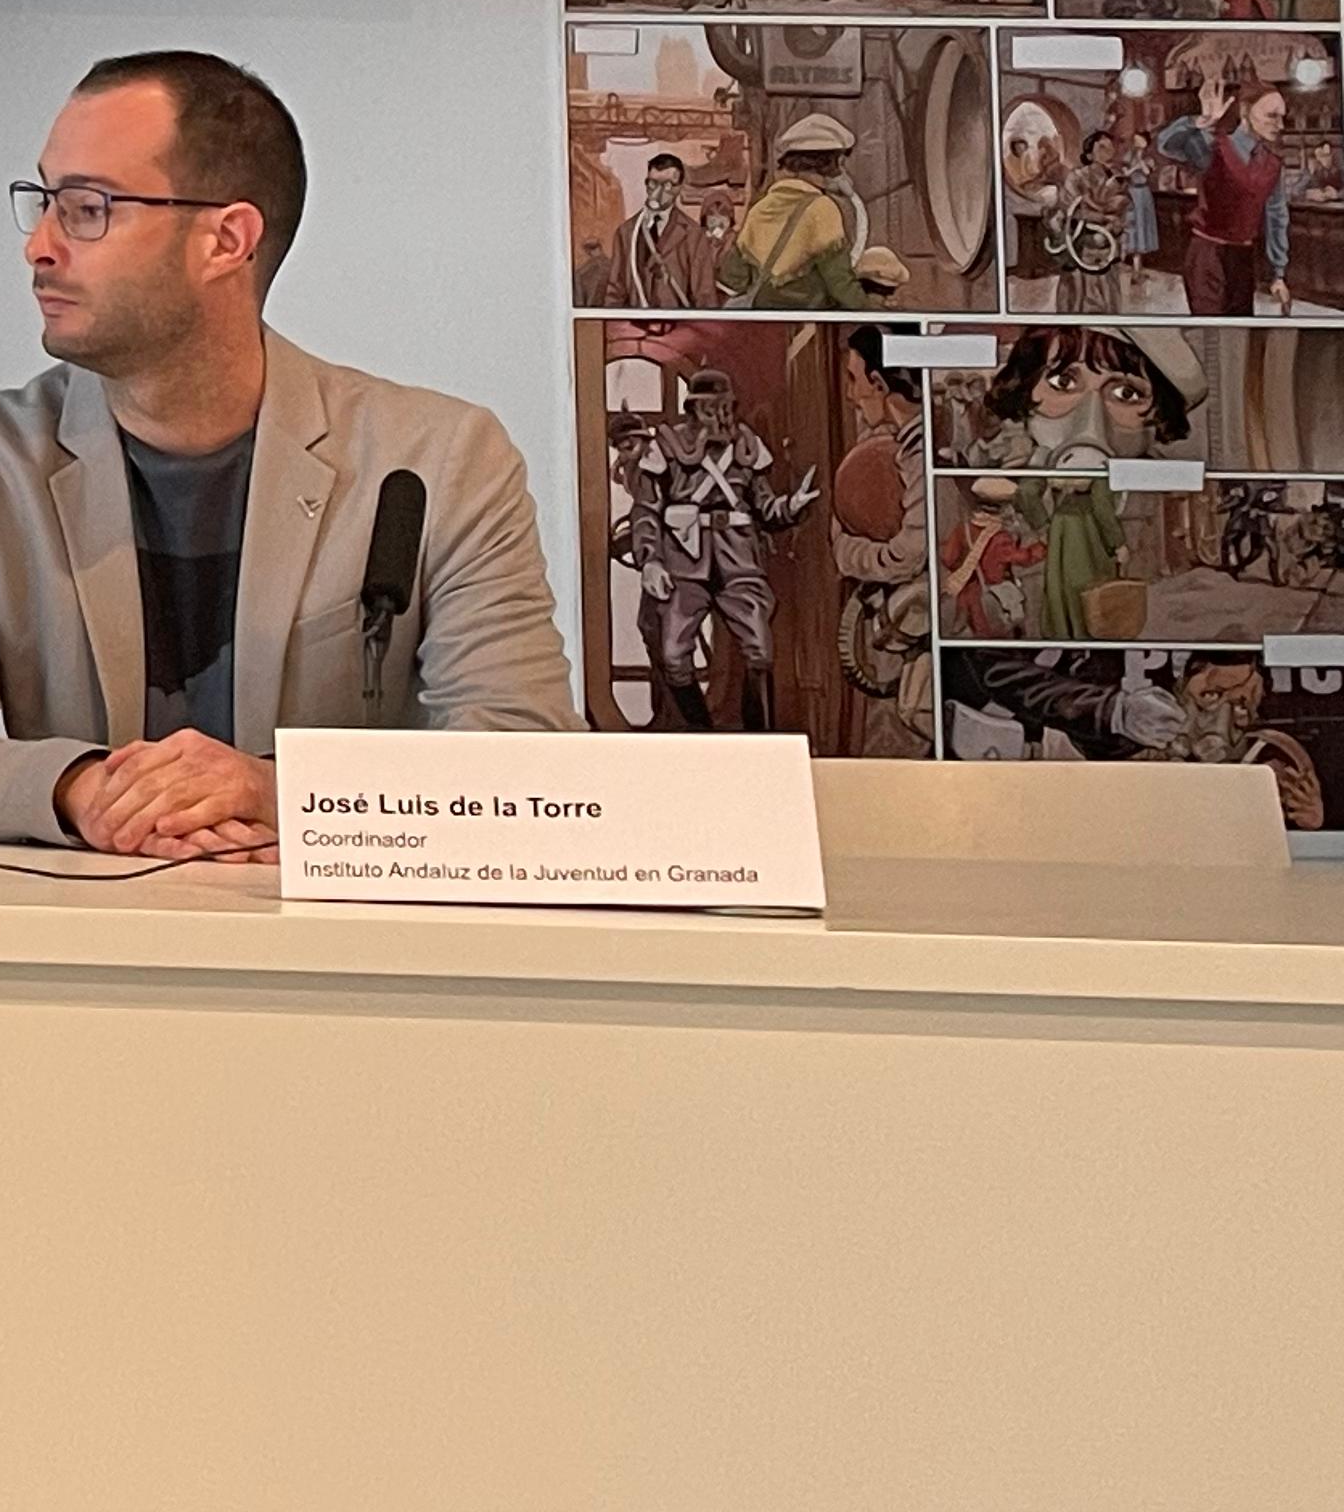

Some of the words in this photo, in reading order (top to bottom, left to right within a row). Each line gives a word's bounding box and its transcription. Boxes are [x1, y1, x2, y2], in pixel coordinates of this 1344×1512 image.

[301, 792, 369, 814] José
[378, 793, 440, 816] Luis
[449, 795, 483, 817] de
[493, 796, 517, 817] la
[526, 797, 602, 818] Torre
[302, 829, 428, 849] Coordinador
[303, 860, 384, 878] Instituto
[388, 861, 471, 881] Andaluz
[477, 864, 503, 881] de
[509, 864, 528, 881] la
[533, 865, 628, 882] Juventud
[634, 869, 661, 882] en
[667, 864, 759, 883] Granada
